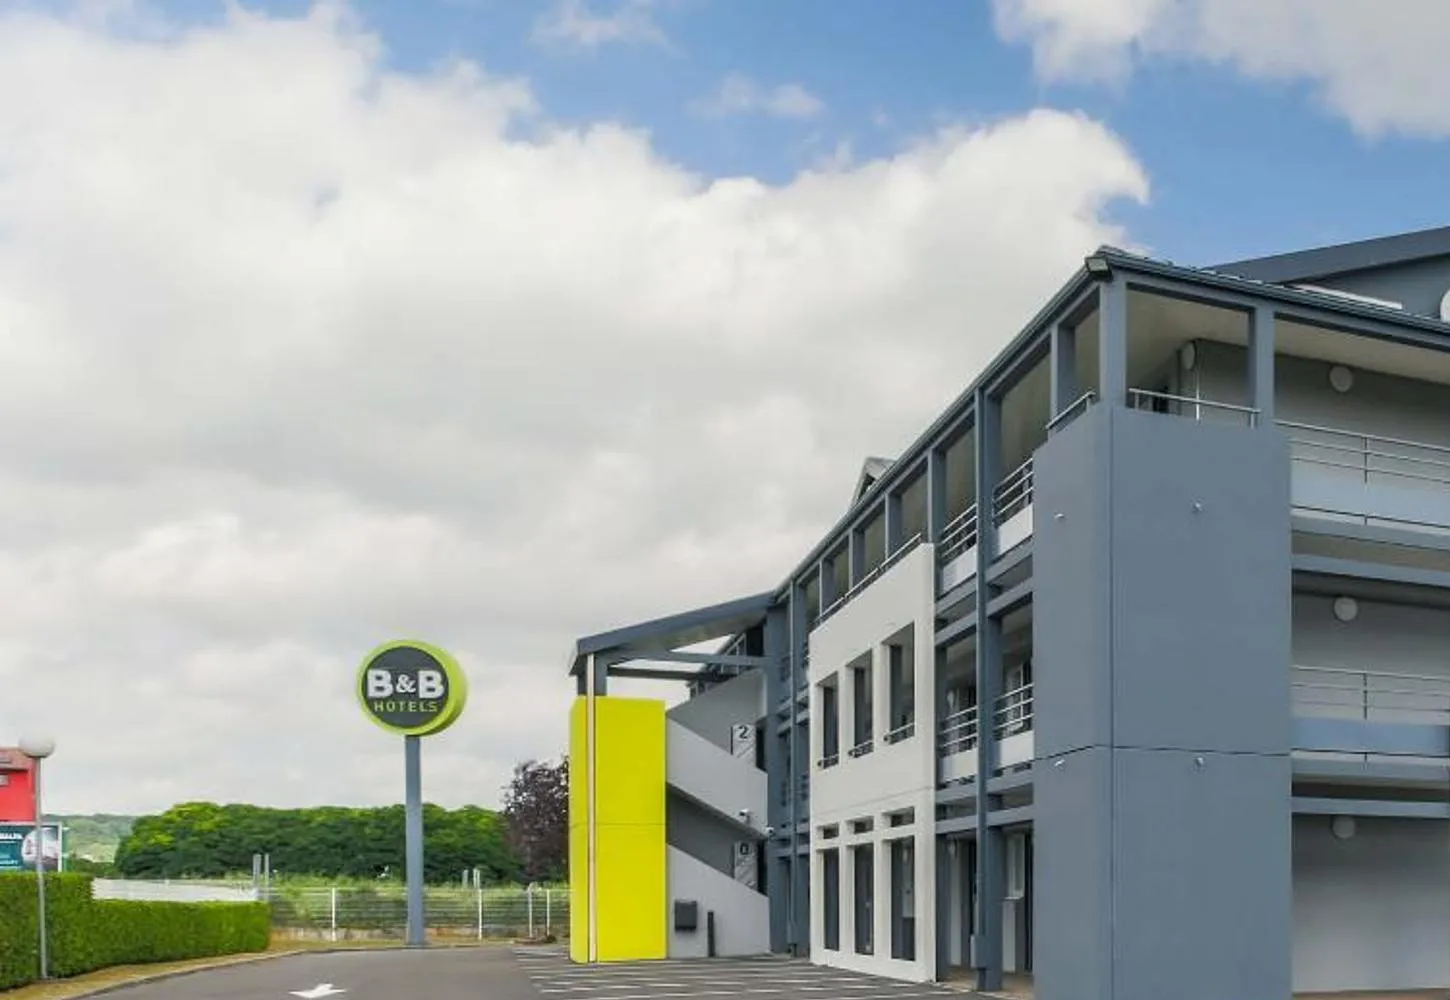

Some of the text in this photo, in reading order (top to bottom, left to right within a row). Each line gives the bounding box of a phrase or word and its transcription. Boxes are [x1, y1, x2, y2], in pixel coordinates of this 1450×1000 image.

[367, 669, 445, 699] B&B
[373, 700, 438, 713] HOTELS
[738, 724, 750, 739] 2
